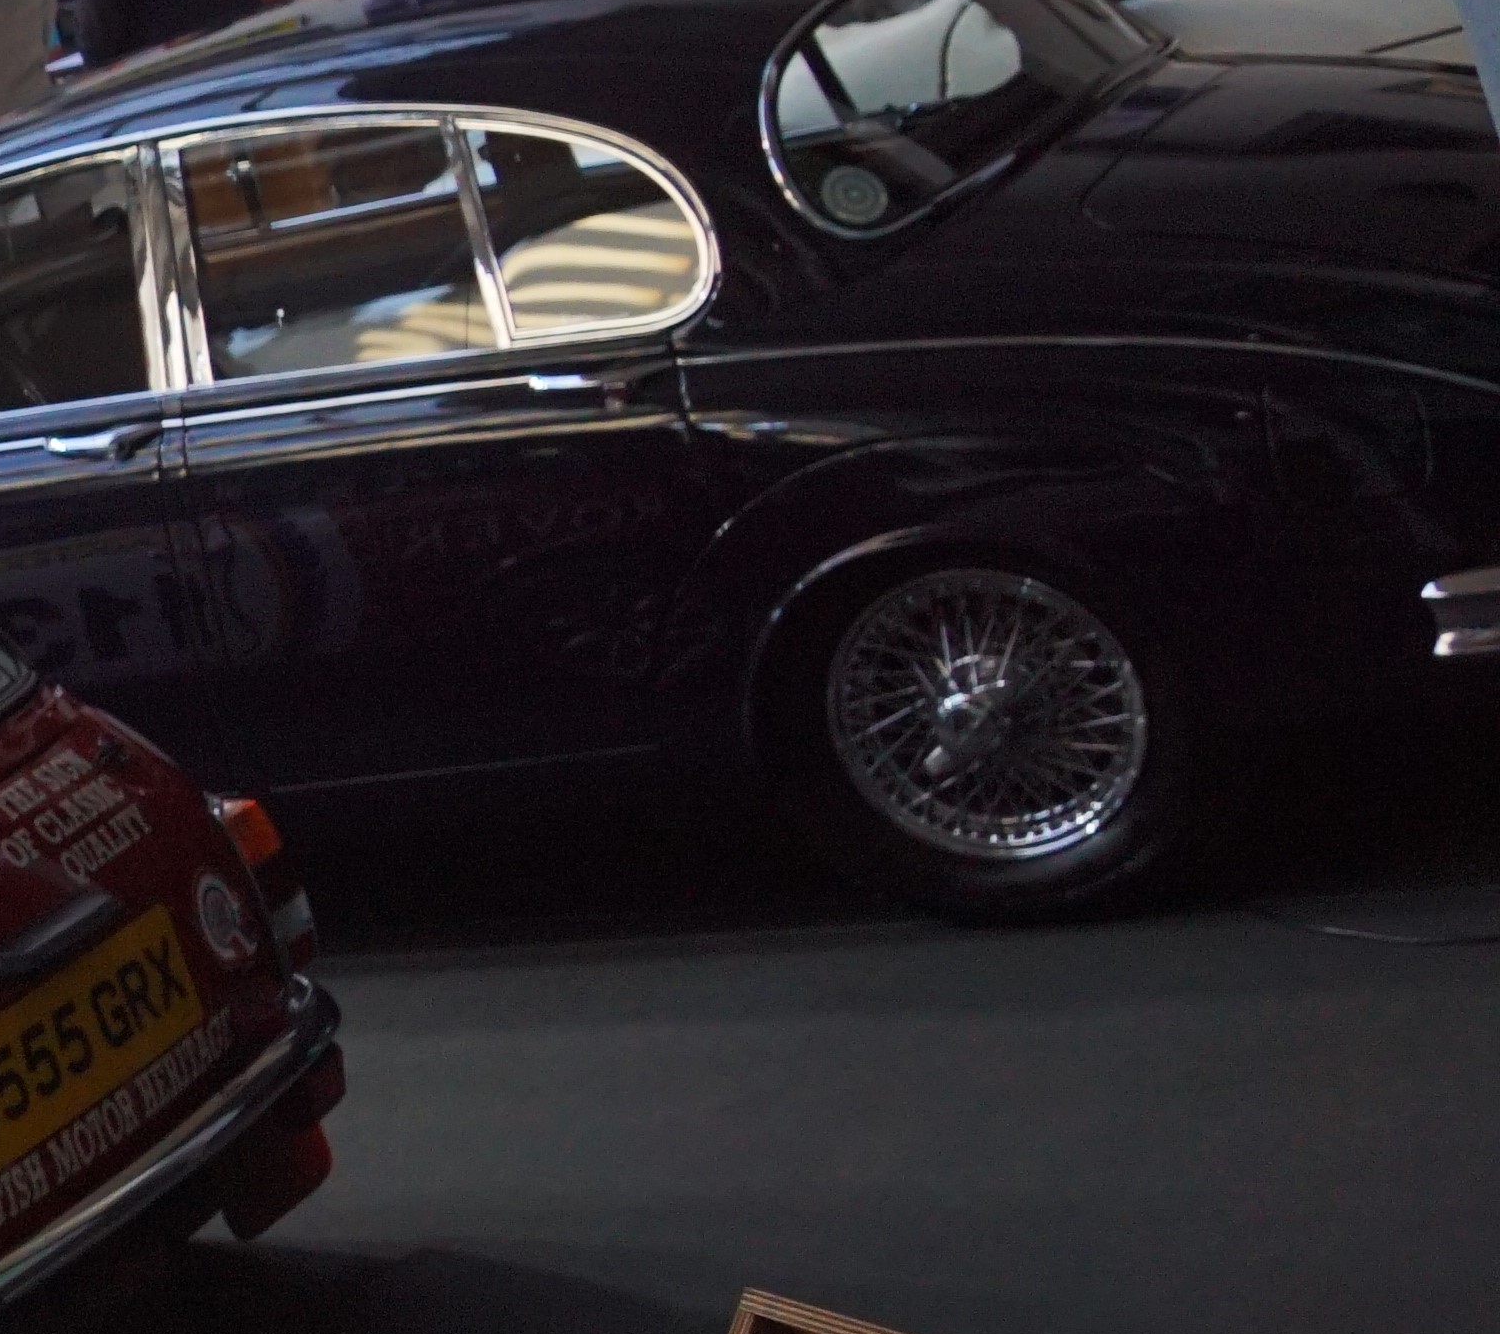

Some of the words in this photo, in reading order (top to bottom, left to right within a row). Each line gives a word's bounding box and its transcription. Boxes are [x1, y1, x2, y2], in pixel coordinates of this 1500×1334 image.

[32, 748, 93, 792] SIGN
[0, 827, 41, 868] OF
[33, 774, 125, 844] CLASSIC
[60, 802, 151, 885] QUALITY
[90, 936, 188, 1047] GRX
[47, 1085, 140, 1185] MOTOR
